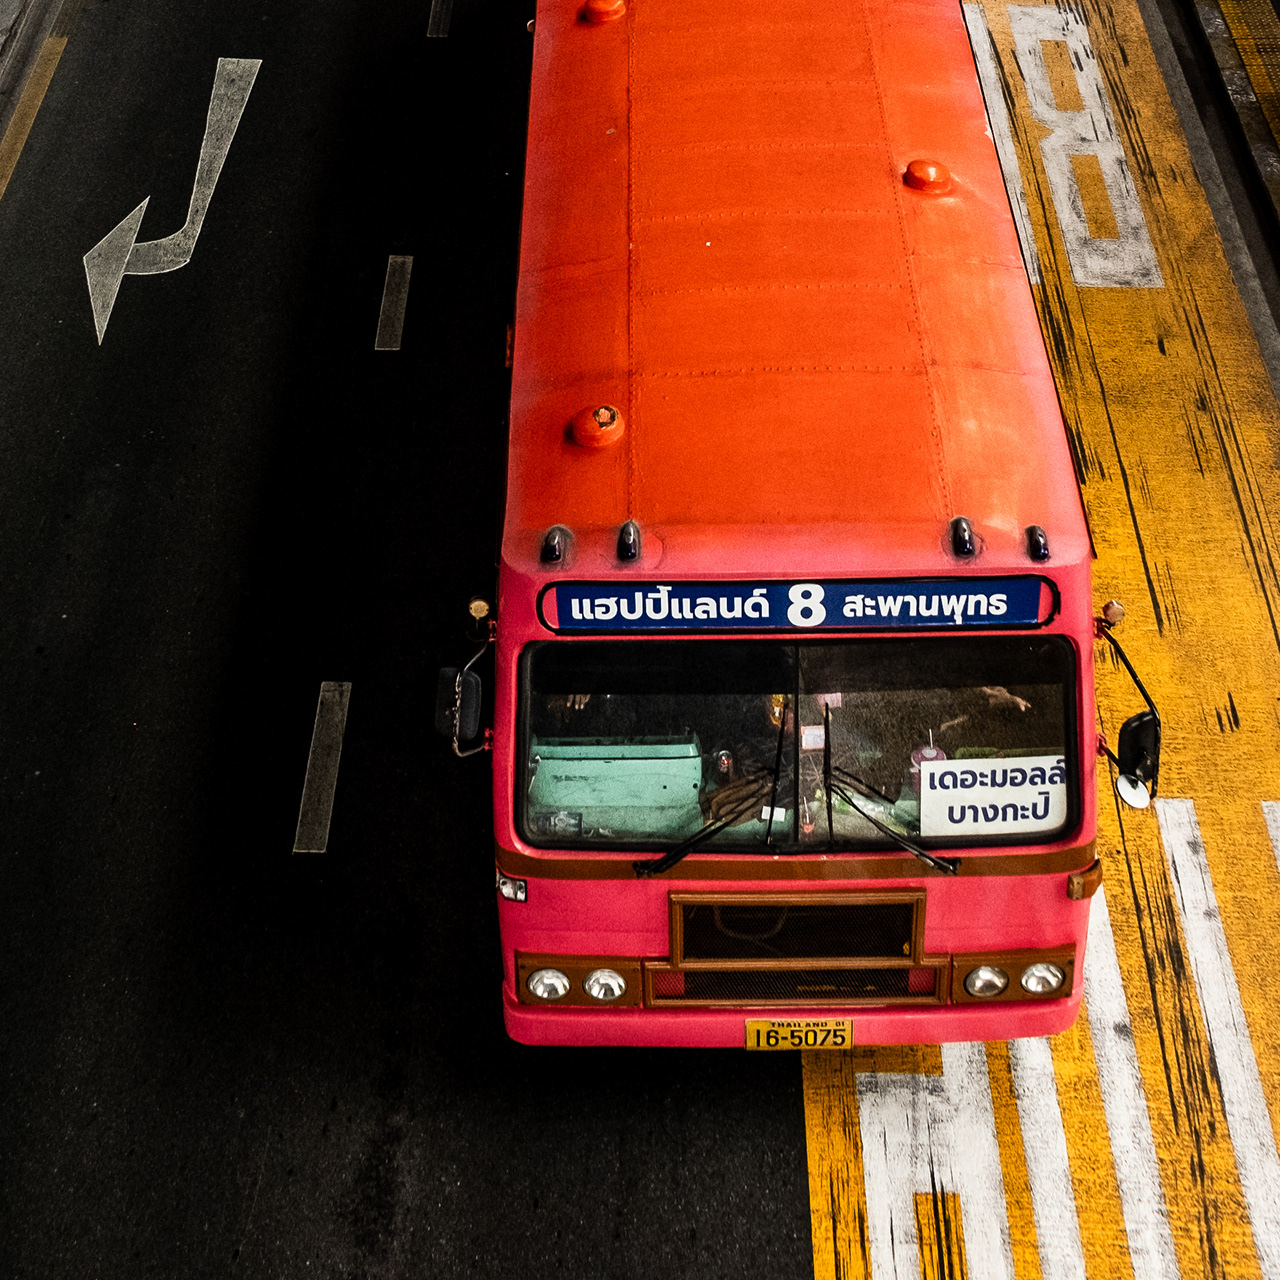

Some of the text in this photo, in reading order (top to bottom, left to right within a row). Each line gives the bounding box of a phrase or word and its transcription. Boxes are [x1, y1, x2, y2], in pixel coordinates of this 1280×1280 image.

[571, 583, 1008, 627] แฮปปี้แลนด์ 8 สะพานพุทธ
[929, 758, 1066, 790] เดอะมอลล์
[948, 791, 1050, 824] บางกะปิ
[756, 1029, 846, 1047] 16-5075
